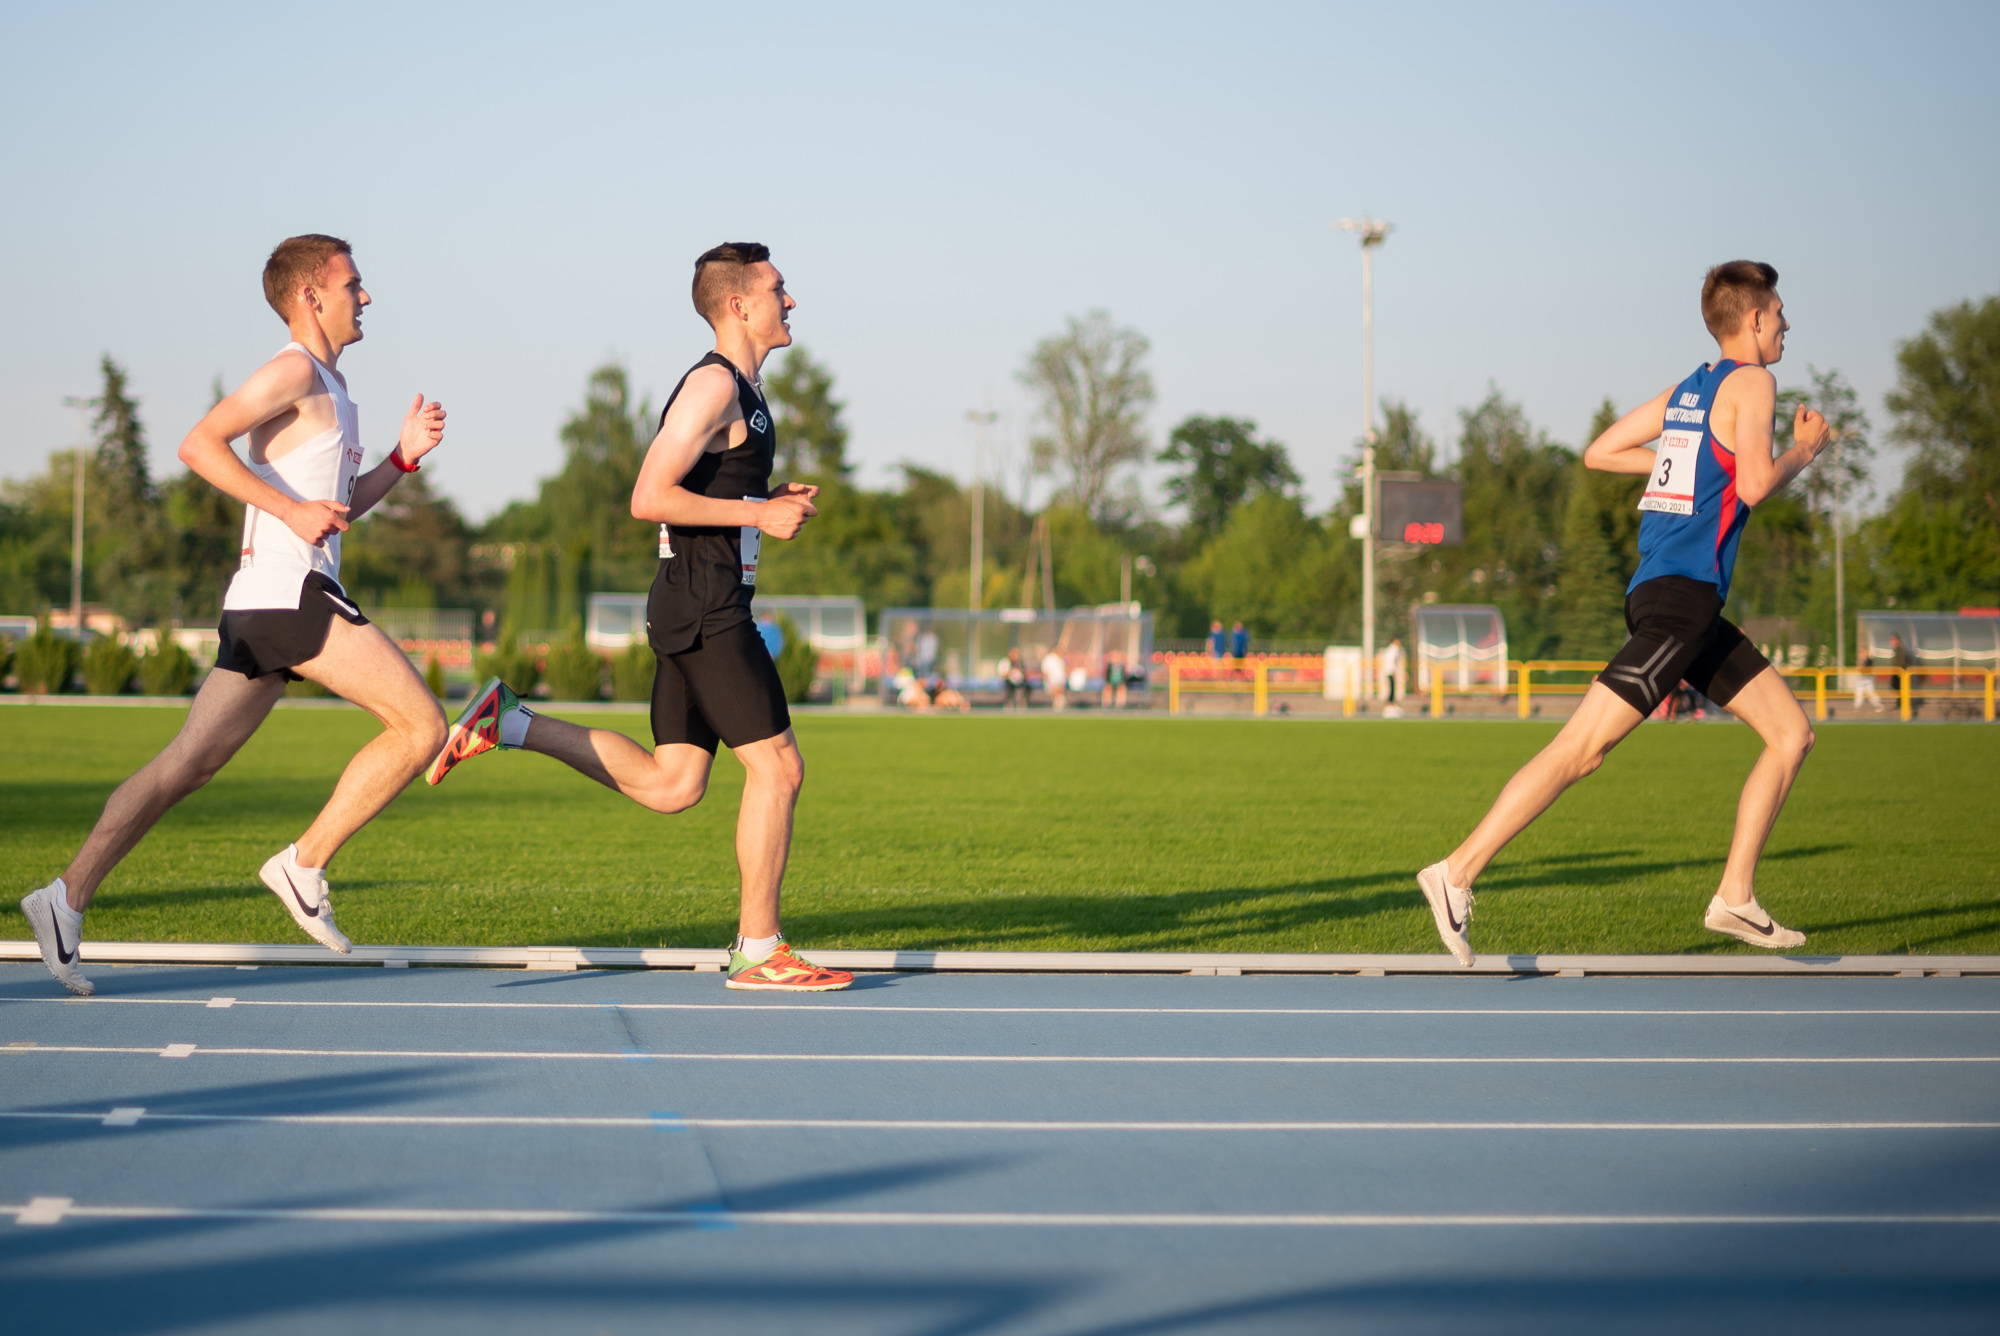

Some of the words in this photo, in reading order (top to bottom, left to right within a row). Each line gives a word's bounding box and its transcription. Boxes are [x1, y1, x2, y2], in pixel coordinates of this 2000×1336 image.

[1669, 437, 1689, 448] ORLEN
[1658, 458, 1672, 487] 3
[1669, 502, 1686, 512] 2021
